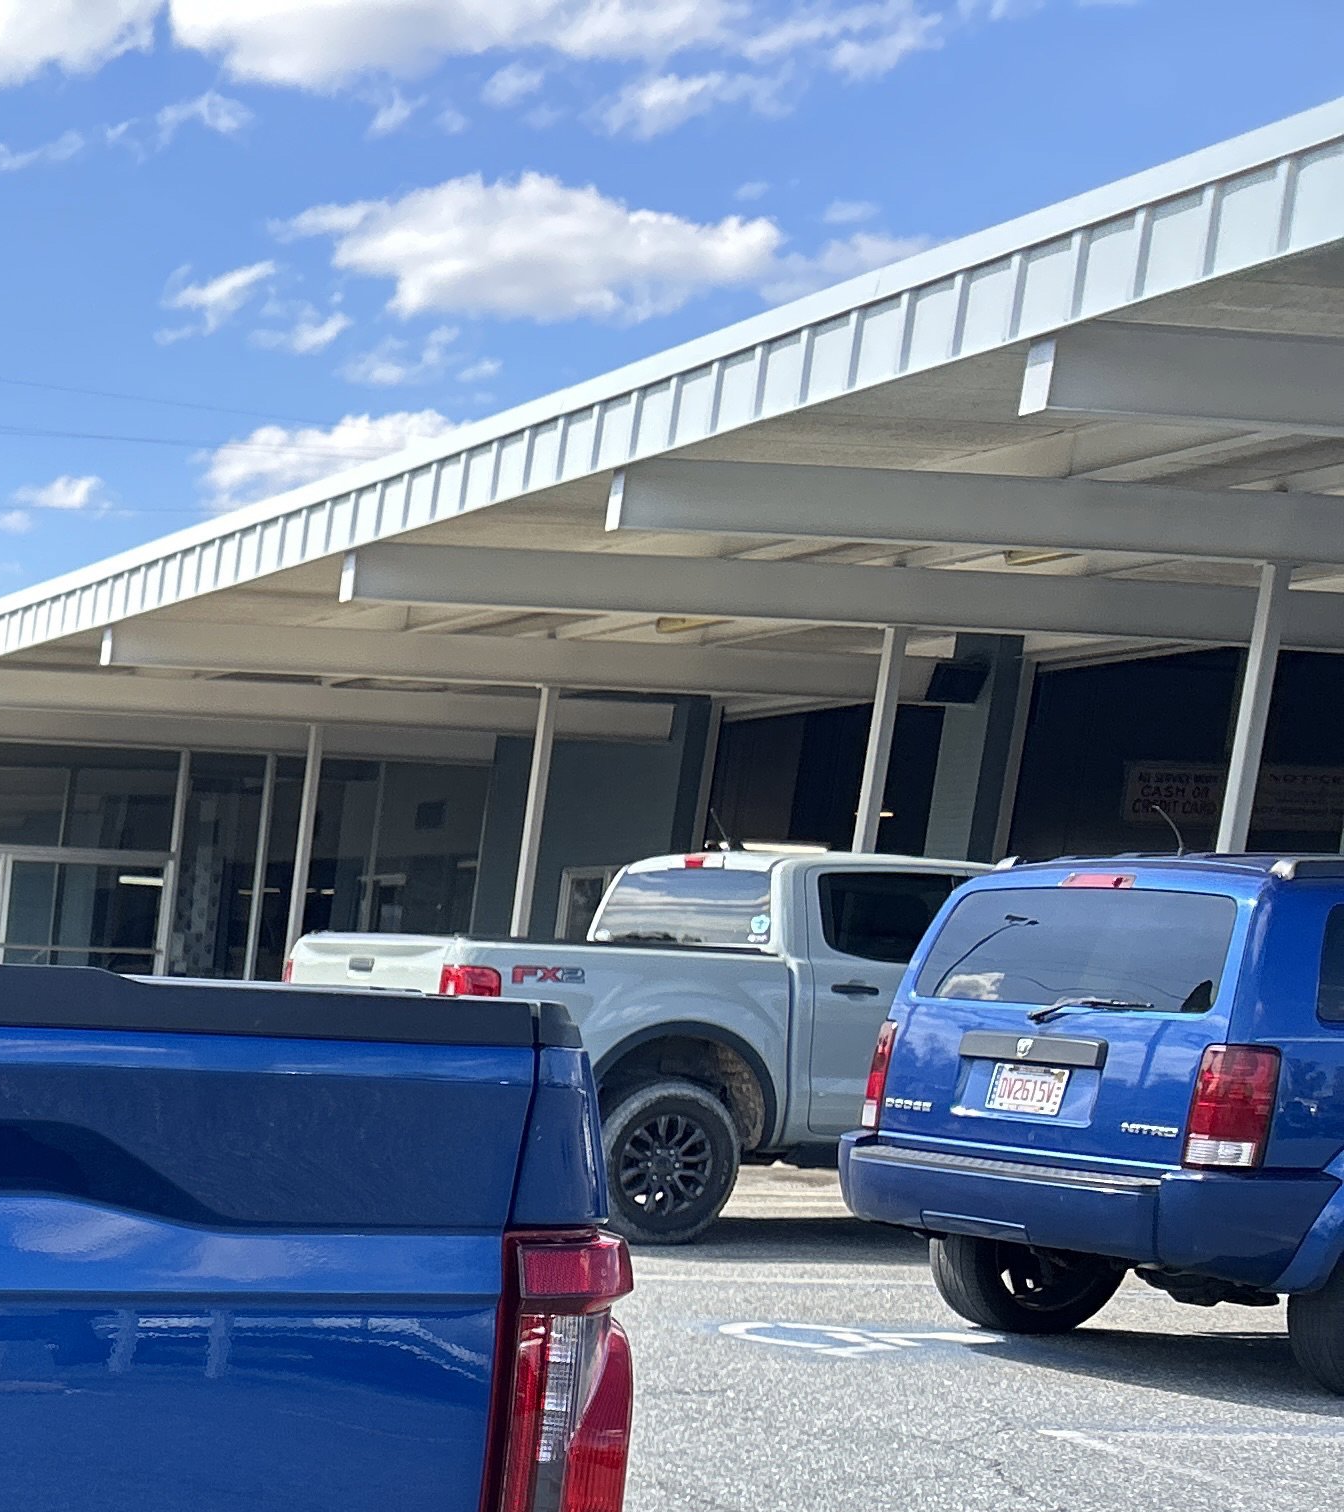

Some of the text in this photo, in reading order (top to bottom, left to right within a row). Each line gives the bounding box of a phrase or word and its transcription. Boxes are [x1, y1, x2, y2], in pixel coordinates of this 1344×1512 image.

[1141, 784, 1185, 797] CASH
[512, 965, 586, 984] FX2
[885, 1097, 932, 1112] DODGE
[1121, 1122, 1178, 1138] NITRO
